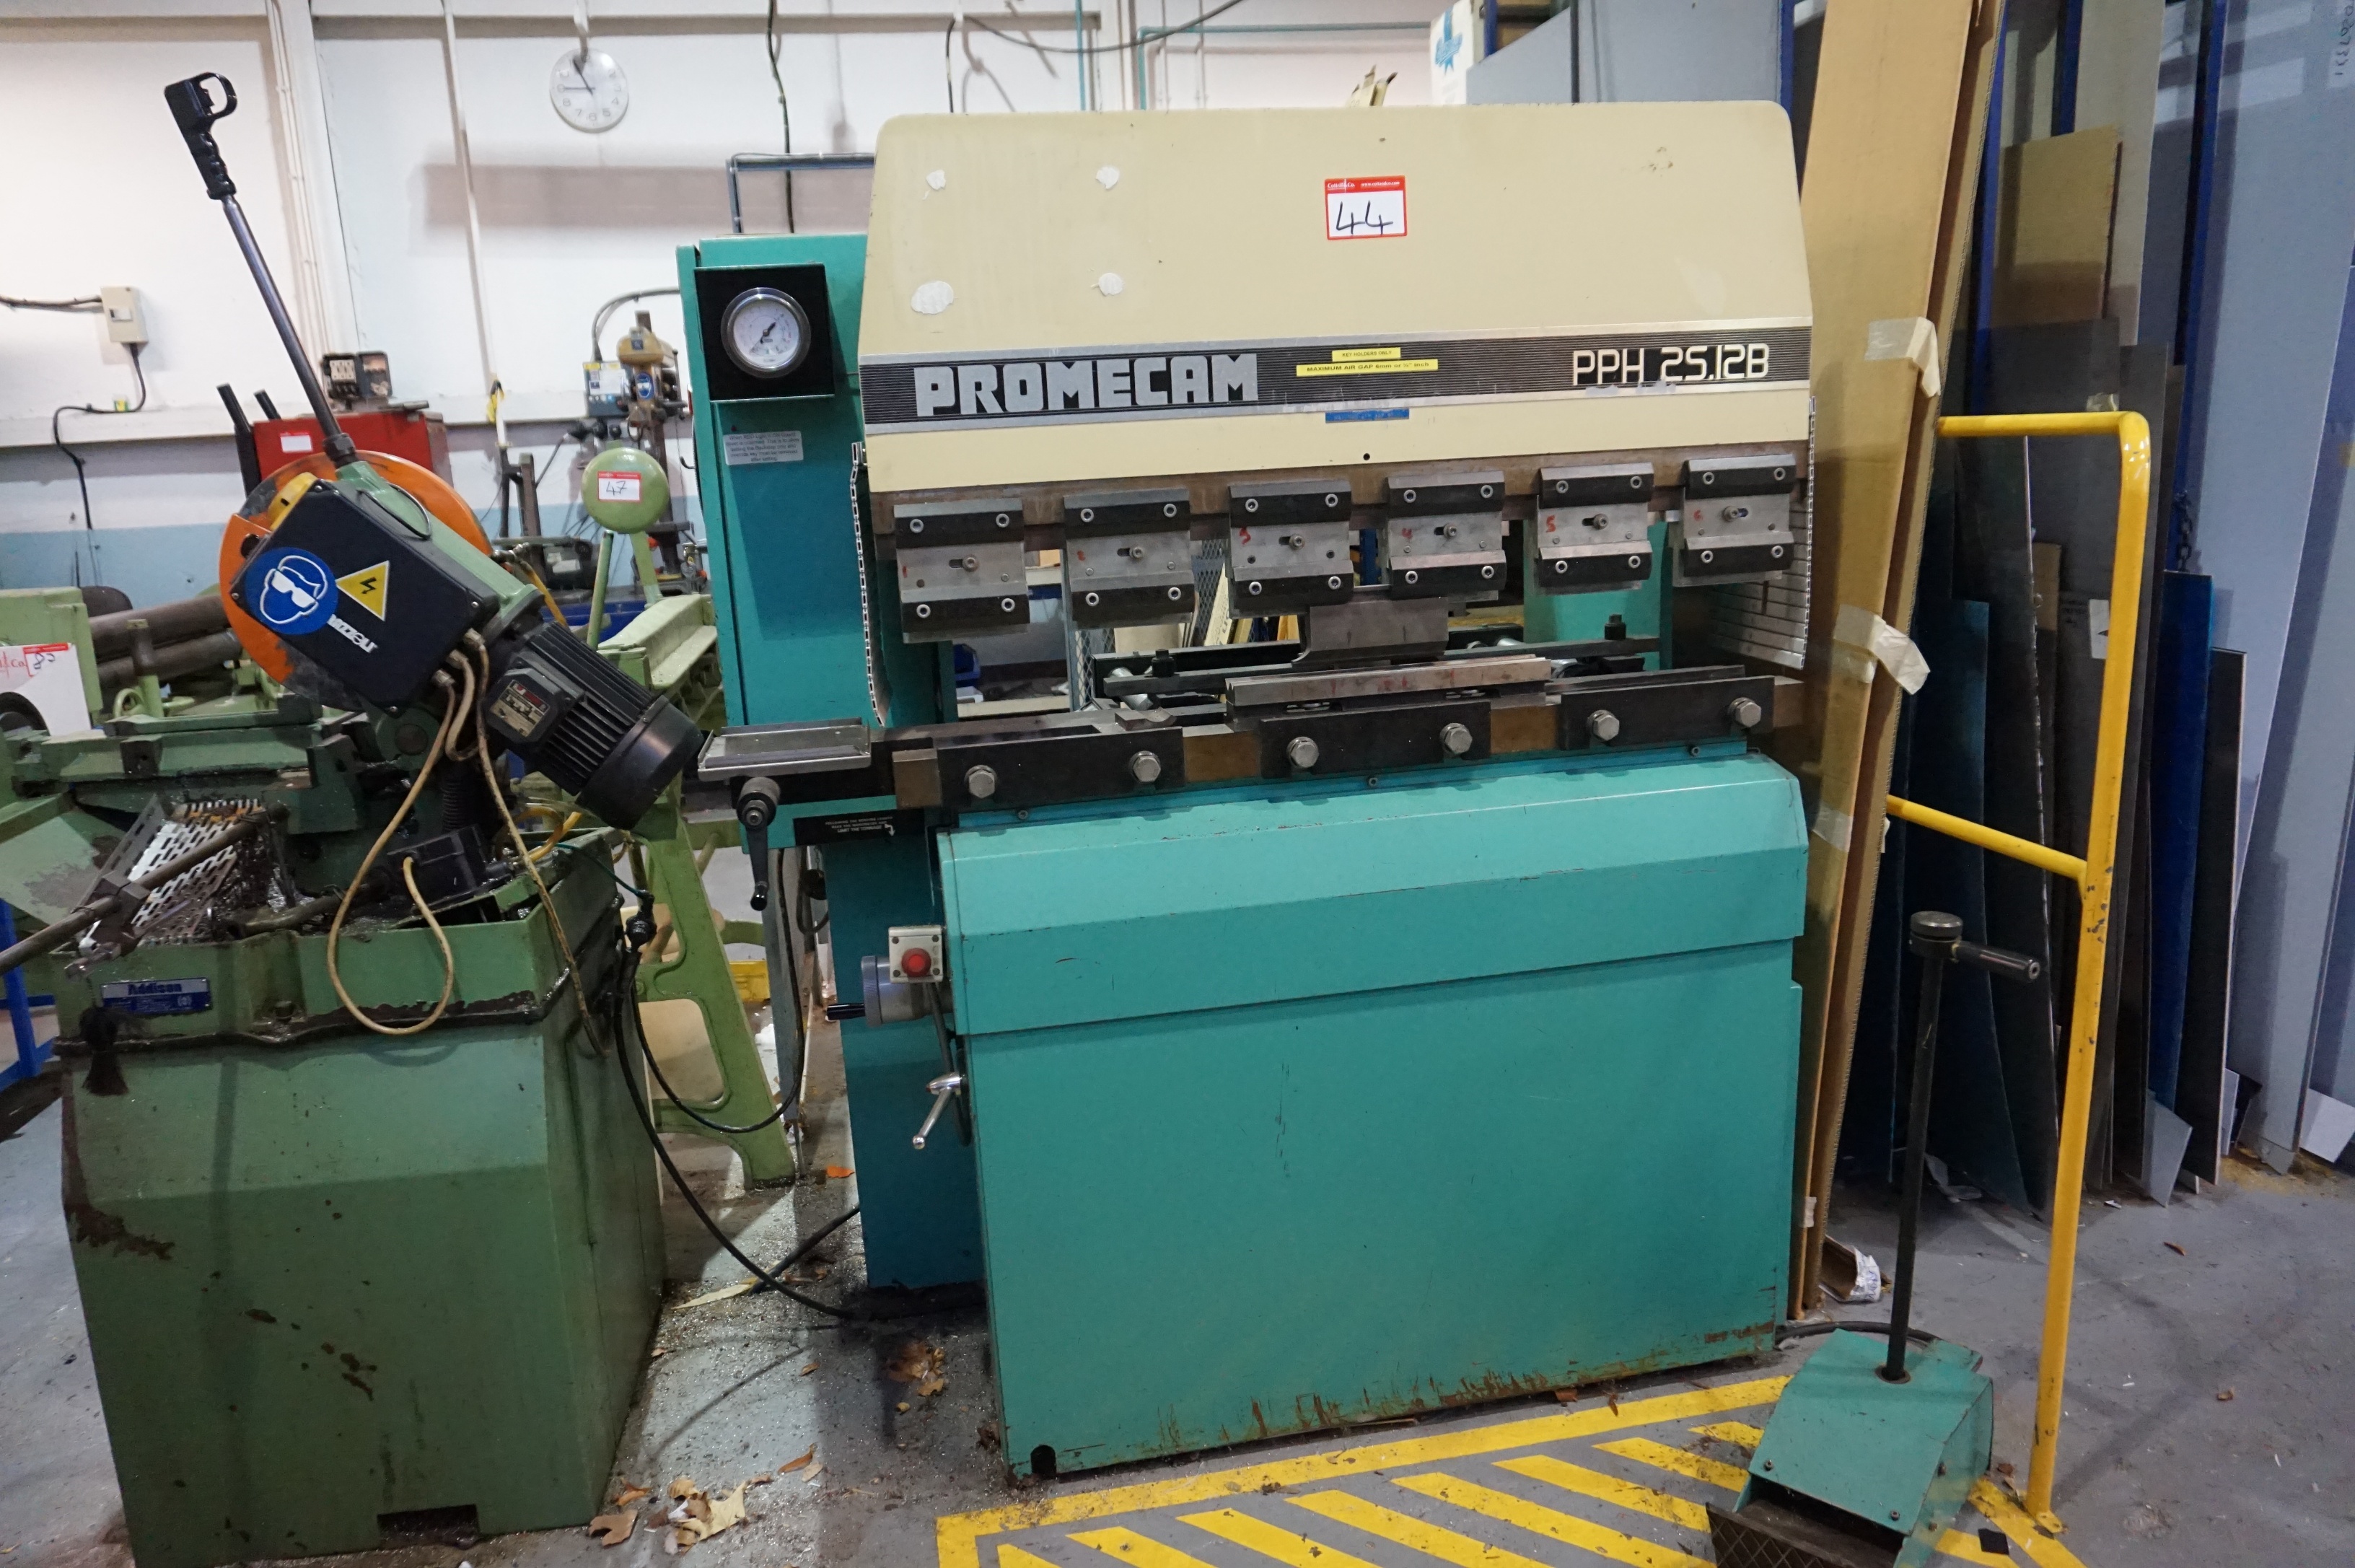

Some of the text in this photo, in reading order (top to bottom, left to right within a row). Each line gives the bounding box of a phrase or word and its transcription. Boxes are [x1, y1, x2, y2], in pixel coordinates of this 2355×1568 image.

[1336, 200, 1394, 235] 44
[1573, 343, 1770, 386] PPH 25.12B
[913, 353, 1259, 417] PROMECAM
[605, 481, 628, 496] 47
